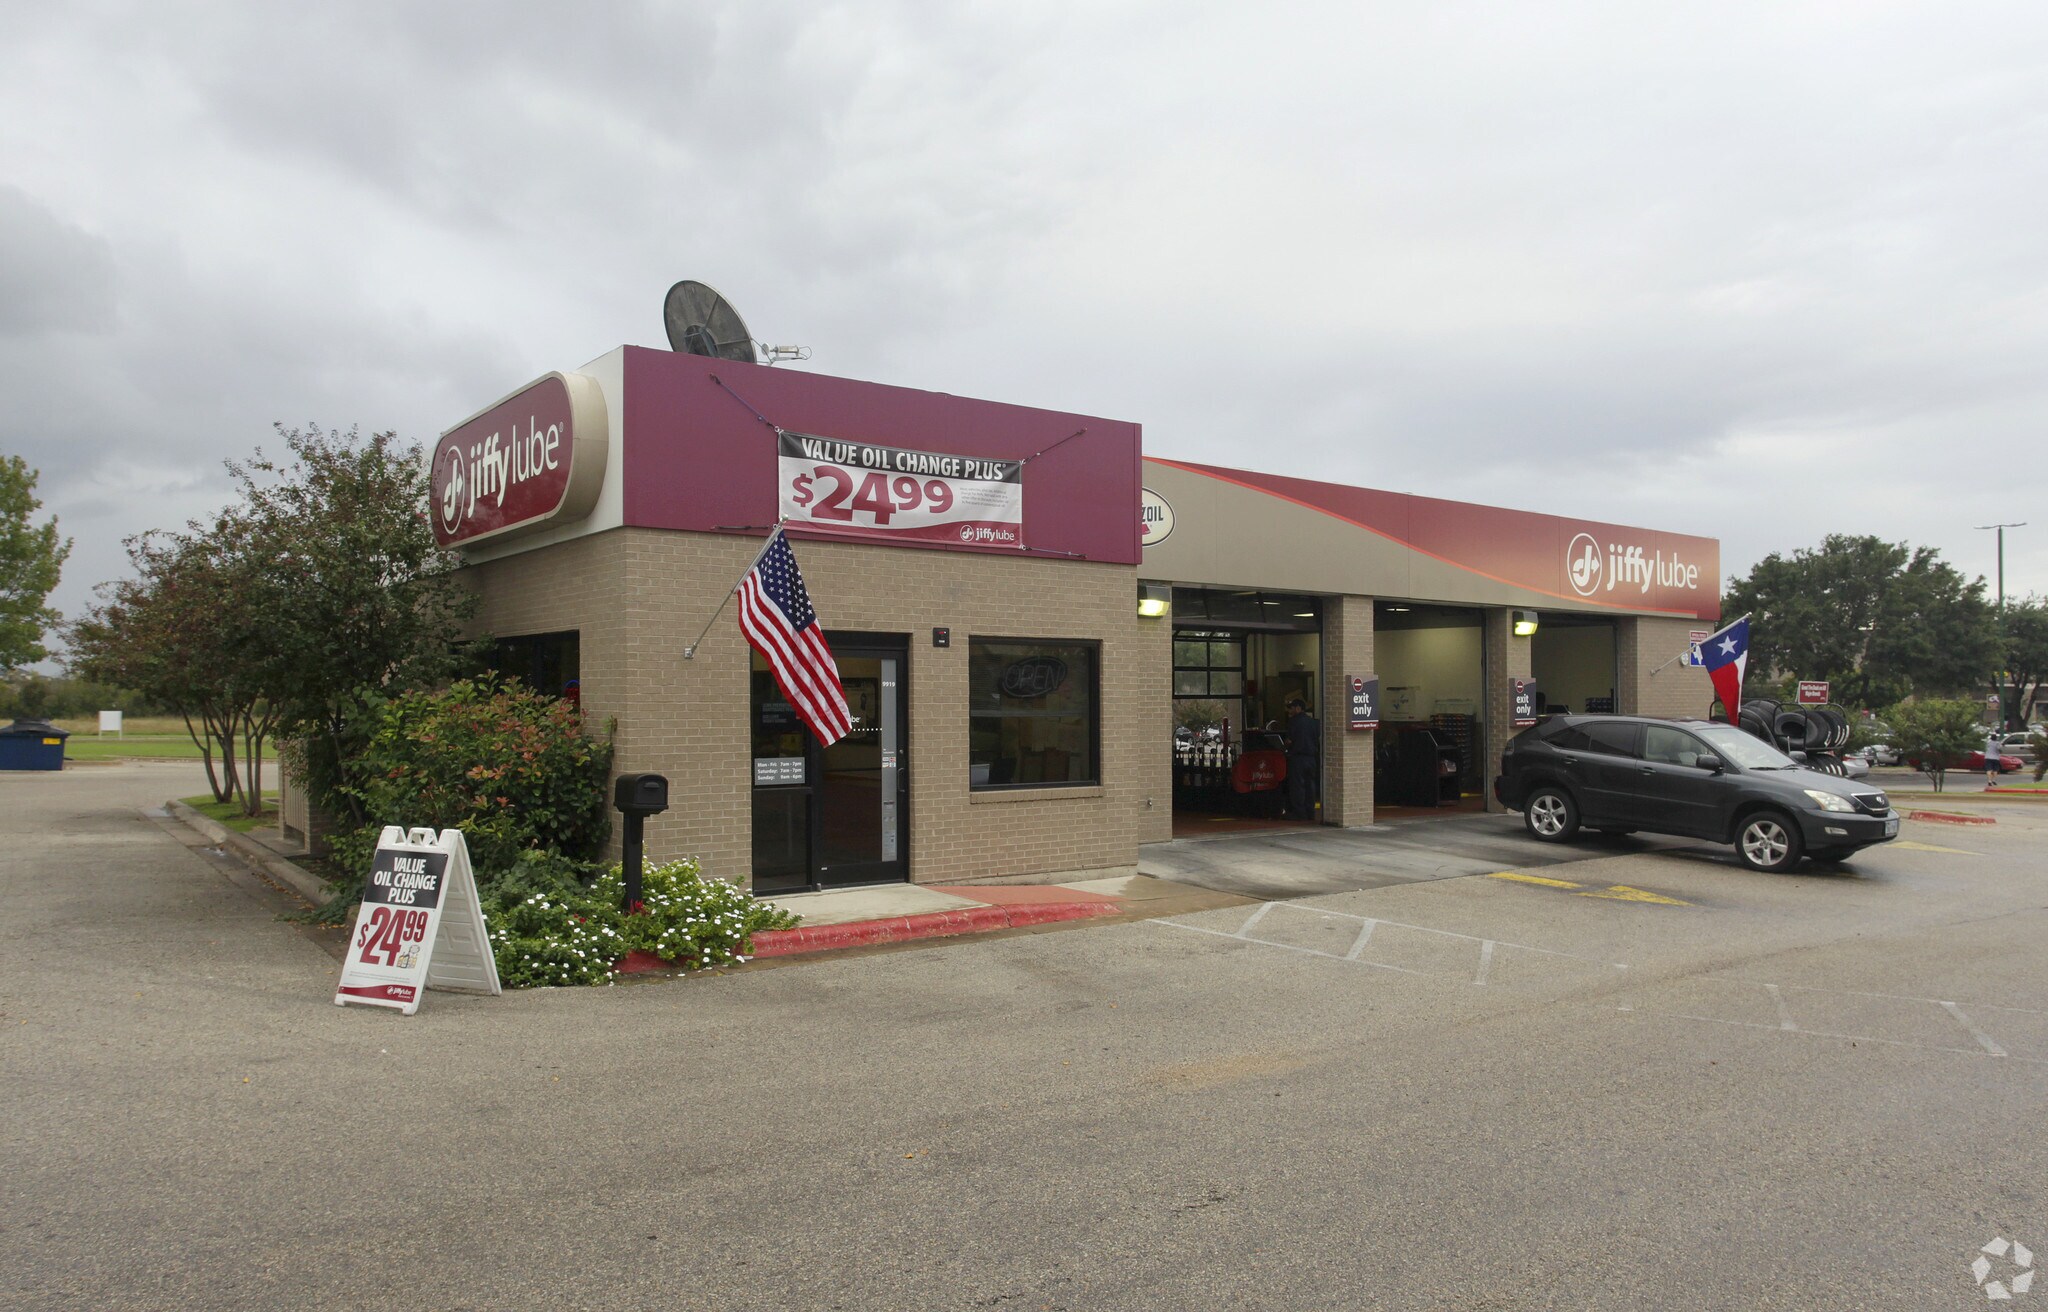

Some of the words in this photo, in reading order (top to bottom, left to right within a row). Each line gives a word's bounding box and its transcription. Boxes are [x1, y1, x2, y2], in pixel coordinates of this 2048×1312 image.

[467, 432, 510, 519] jiffy
[512, 415, 560, 485] lube
[801, 438, 857, 464] VALUE
[862, 448, 891, 470] OIL
[896, 452, 959, 477] CHANGE
[964, 460, 1004, 480] PLUS
[975, 528, 995, 542] jiffy
[995, 529, 1015, 541] lube
[1606, 543, 1654, 594] jiffy
[1656, 550, 1698, 590] lube
[1004, 664, 1061, 689] OPEN
[1353, 692, 1370, 704] exit
[1516, 693, 1529, 704] exit
[1353, 703, 1372, 717] only
[1516, 703, 1531, 716] only
[393, 856, 426, 874] VALUE
[374, 871, 392, 887] OIL
[393, 873, 437, 891] CHANGE
[387, 887, 416, 904] PLUS
